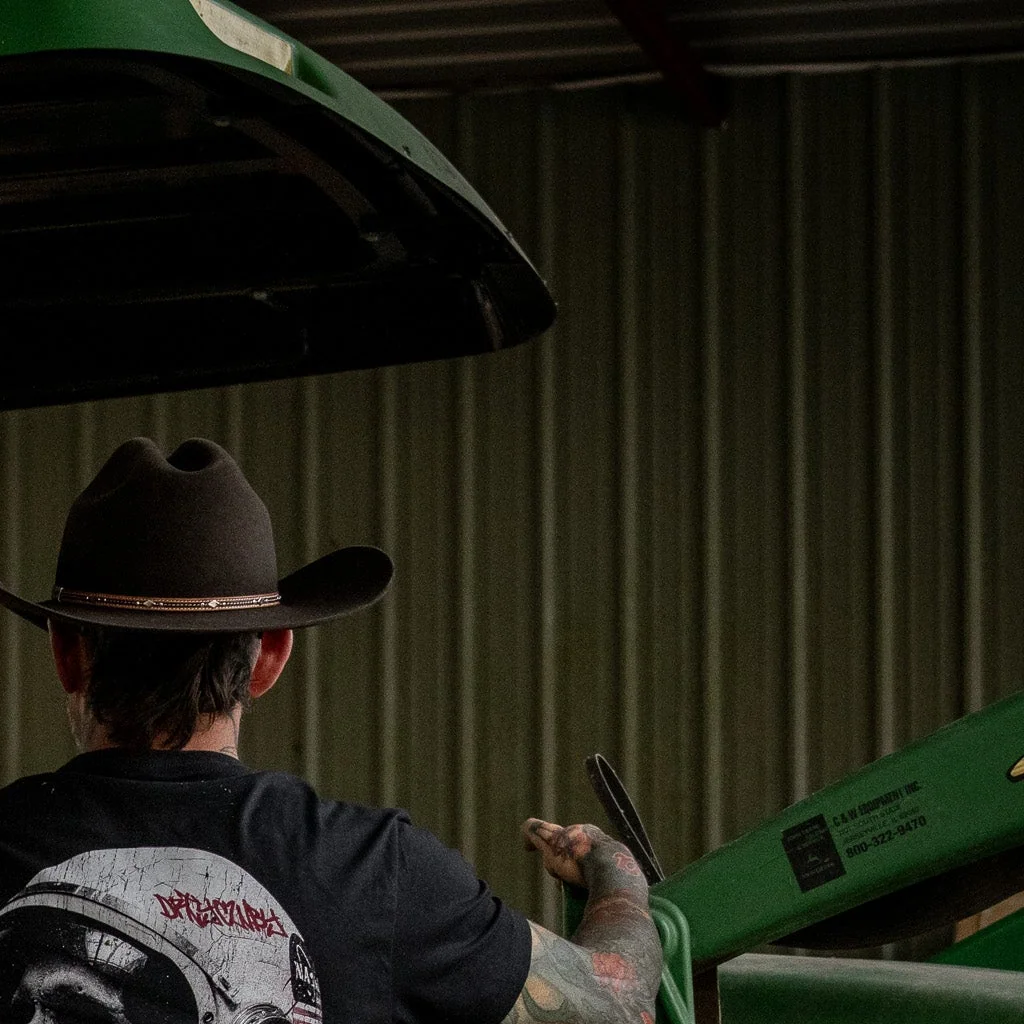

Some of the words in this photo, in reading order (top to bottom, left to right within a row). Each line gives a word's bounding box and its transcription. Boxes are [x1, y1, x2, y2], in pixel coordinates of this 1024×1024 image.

[848, 808, 858, 821] W
[858, 788, 904, 816] EQUIPMENT
[845, 815, 927, 859] 800-322-9470
